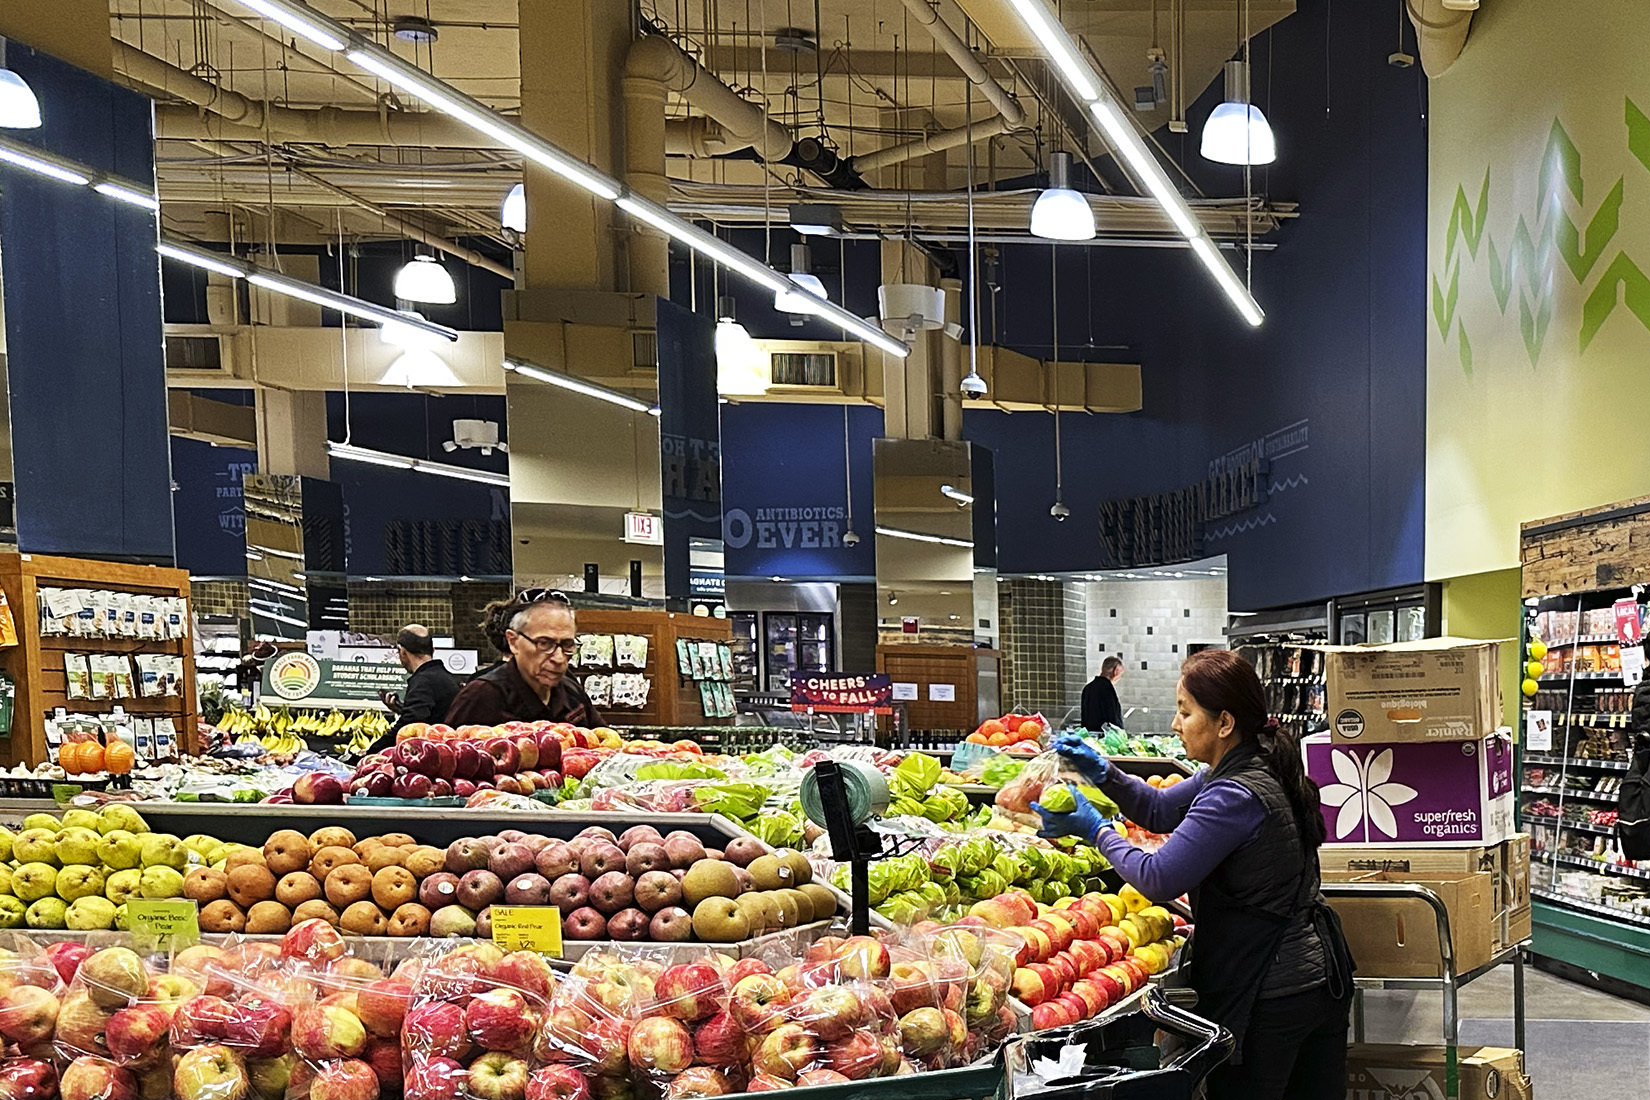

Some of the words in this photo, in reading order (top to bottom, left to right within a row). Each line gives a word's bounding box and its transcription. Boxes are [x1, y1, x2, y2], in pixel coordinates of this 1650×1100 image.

[1616, 605, 1636, 616] LOCAL
[808, 676, 866, 691] CHEERS
[822, 691, 837, 700] TO
[839, 690, 877, 704] FALL
[1380, 699, 1427, 709] biologique
[1343, 724, 1359, 732] USDA
[1426, 723, 1475, 738] Rainier
[1414, 809, 1476, 824] superfresh
[1423, 824, 1477, 837] organics
[138, 914, 167, 923] Organic
